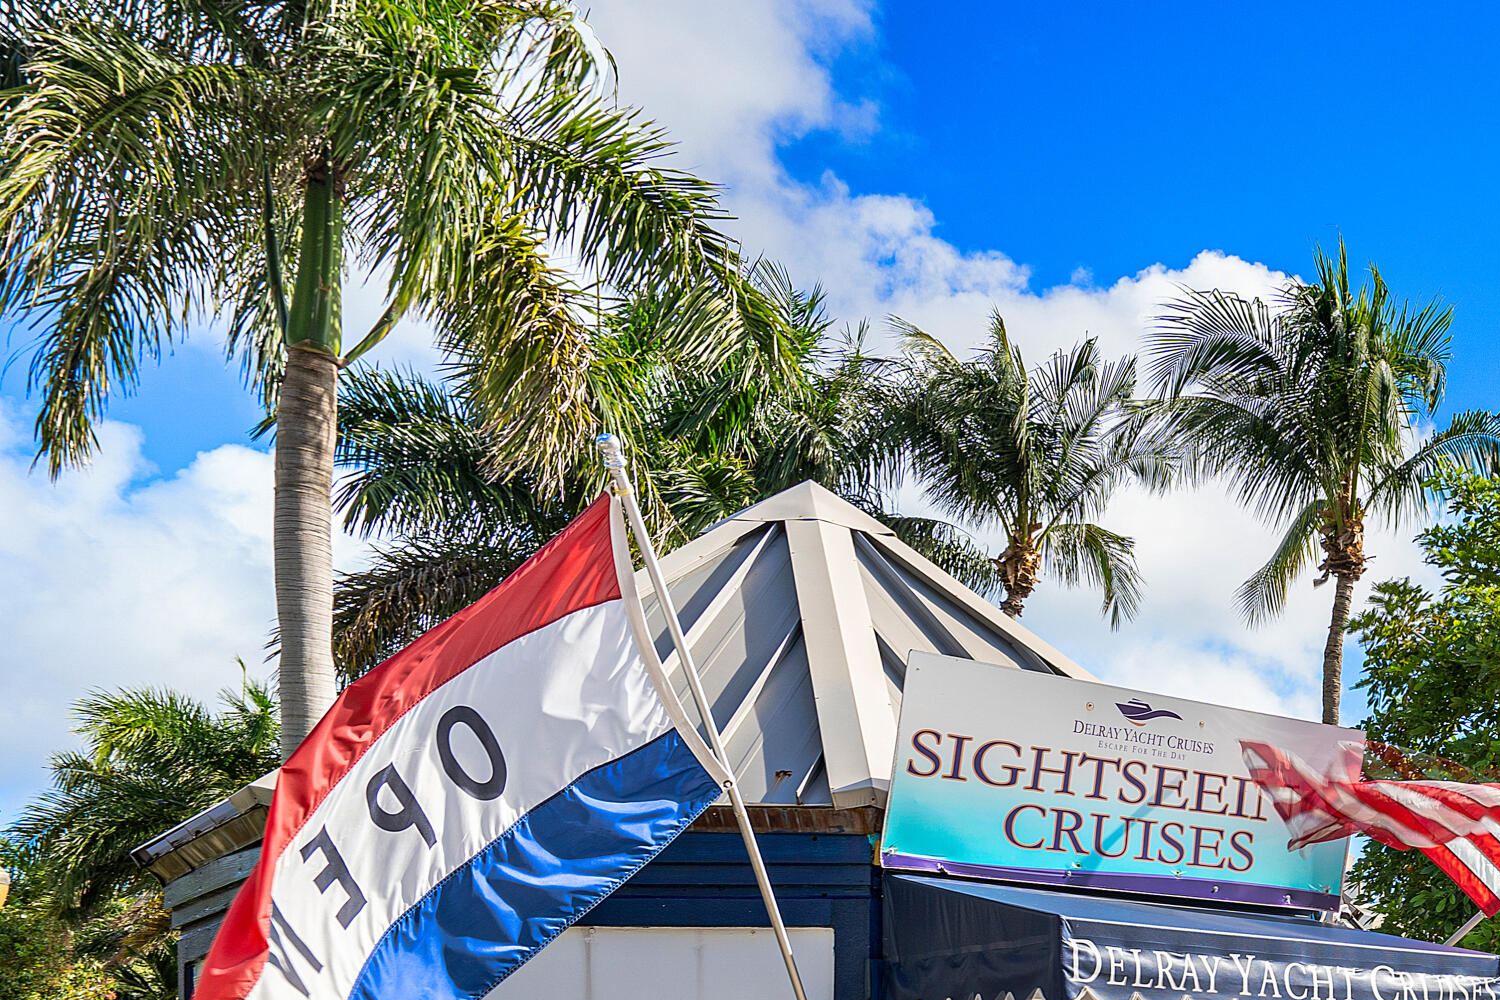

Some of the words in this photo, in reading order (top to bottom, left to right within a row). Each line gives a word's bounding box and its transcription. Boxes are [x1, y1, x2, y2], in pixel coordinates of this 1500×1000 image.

[1073, 719, 1122, 740] DELRAY
[1123, 728, 1165, 746] YACHT
[1167, 735, 1214, 754] CRUISES
[1098, 740, 1128, 752] ESCAPE
[1132, 745, 1148, 755] FOR
[1152, 748, 1167, 758] THE
[1170, 751, 1186, 761] DAY
[906, 728, 1268, 822] SIGHTSEEI
[1003, 803, 1255, 873] CRUISES
[1068, 938, 1221, 994] DELRAY
